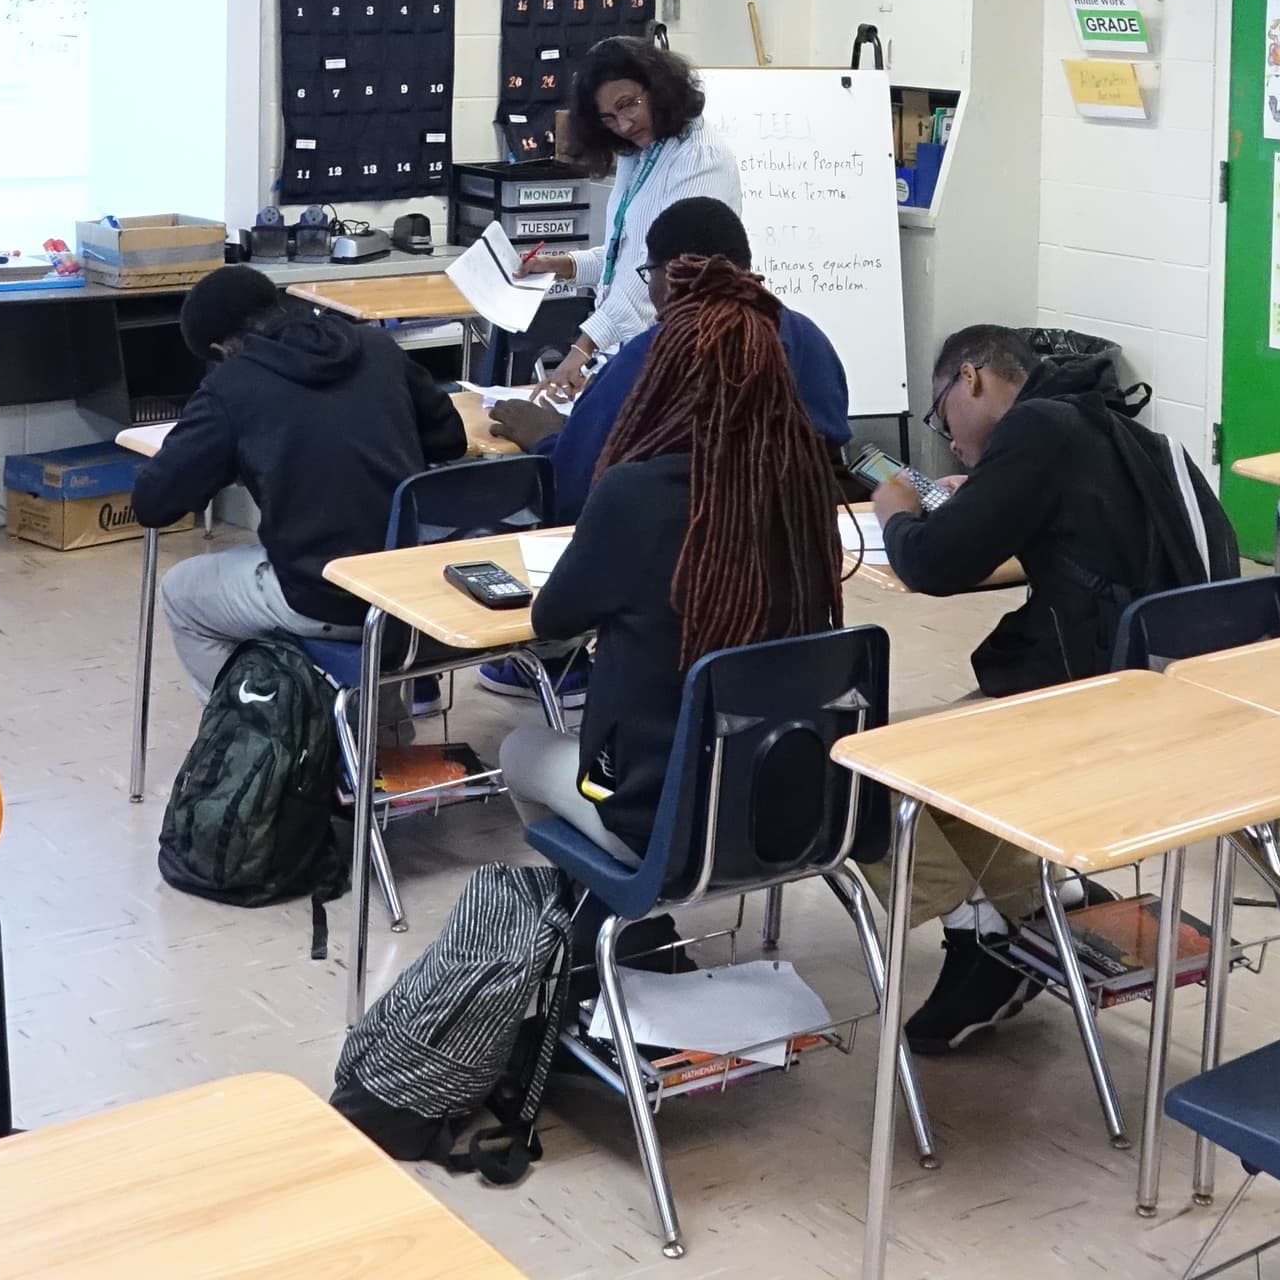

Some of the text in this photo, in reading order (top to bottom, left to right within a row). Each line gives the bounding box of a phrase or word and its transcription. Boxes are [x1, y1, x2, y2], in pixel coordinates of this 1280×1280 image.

[297, 7, 304, 17] 1
[332, 6, 340, 16] 2
[366, 6, 375, 15] 3
[400, 5, 408, 15] 4
[432, 4, 440, 14] 5
[1086, 17, 1139, 32] GRADE
[297, 88, 305, 98] 6
[332, 88, 340, 98] 7
[365, 86, 373, 95] 8
[400, 84, 408, 94] 9
[430, 83, 444, 93] 10
[397, 162, 411, 172] 14
[429, 161, 443, 171] 15
[735, 151, 864, 176] stributive Property
[297, 169, 310, 179] 11
[328, 166, 342, 176] 12
[363, 165, 377, 175] 13
[523, 189, 570, 201] MONDAY
[769, 182, 796, 199] Like
[804, 182, 846, 200] Terms
[521, 222, 571, 233] TUESDAY
[751, 255, 882, 281] ultaneous equations
[681, 1060, 729, 1081] MATHEMATIC
